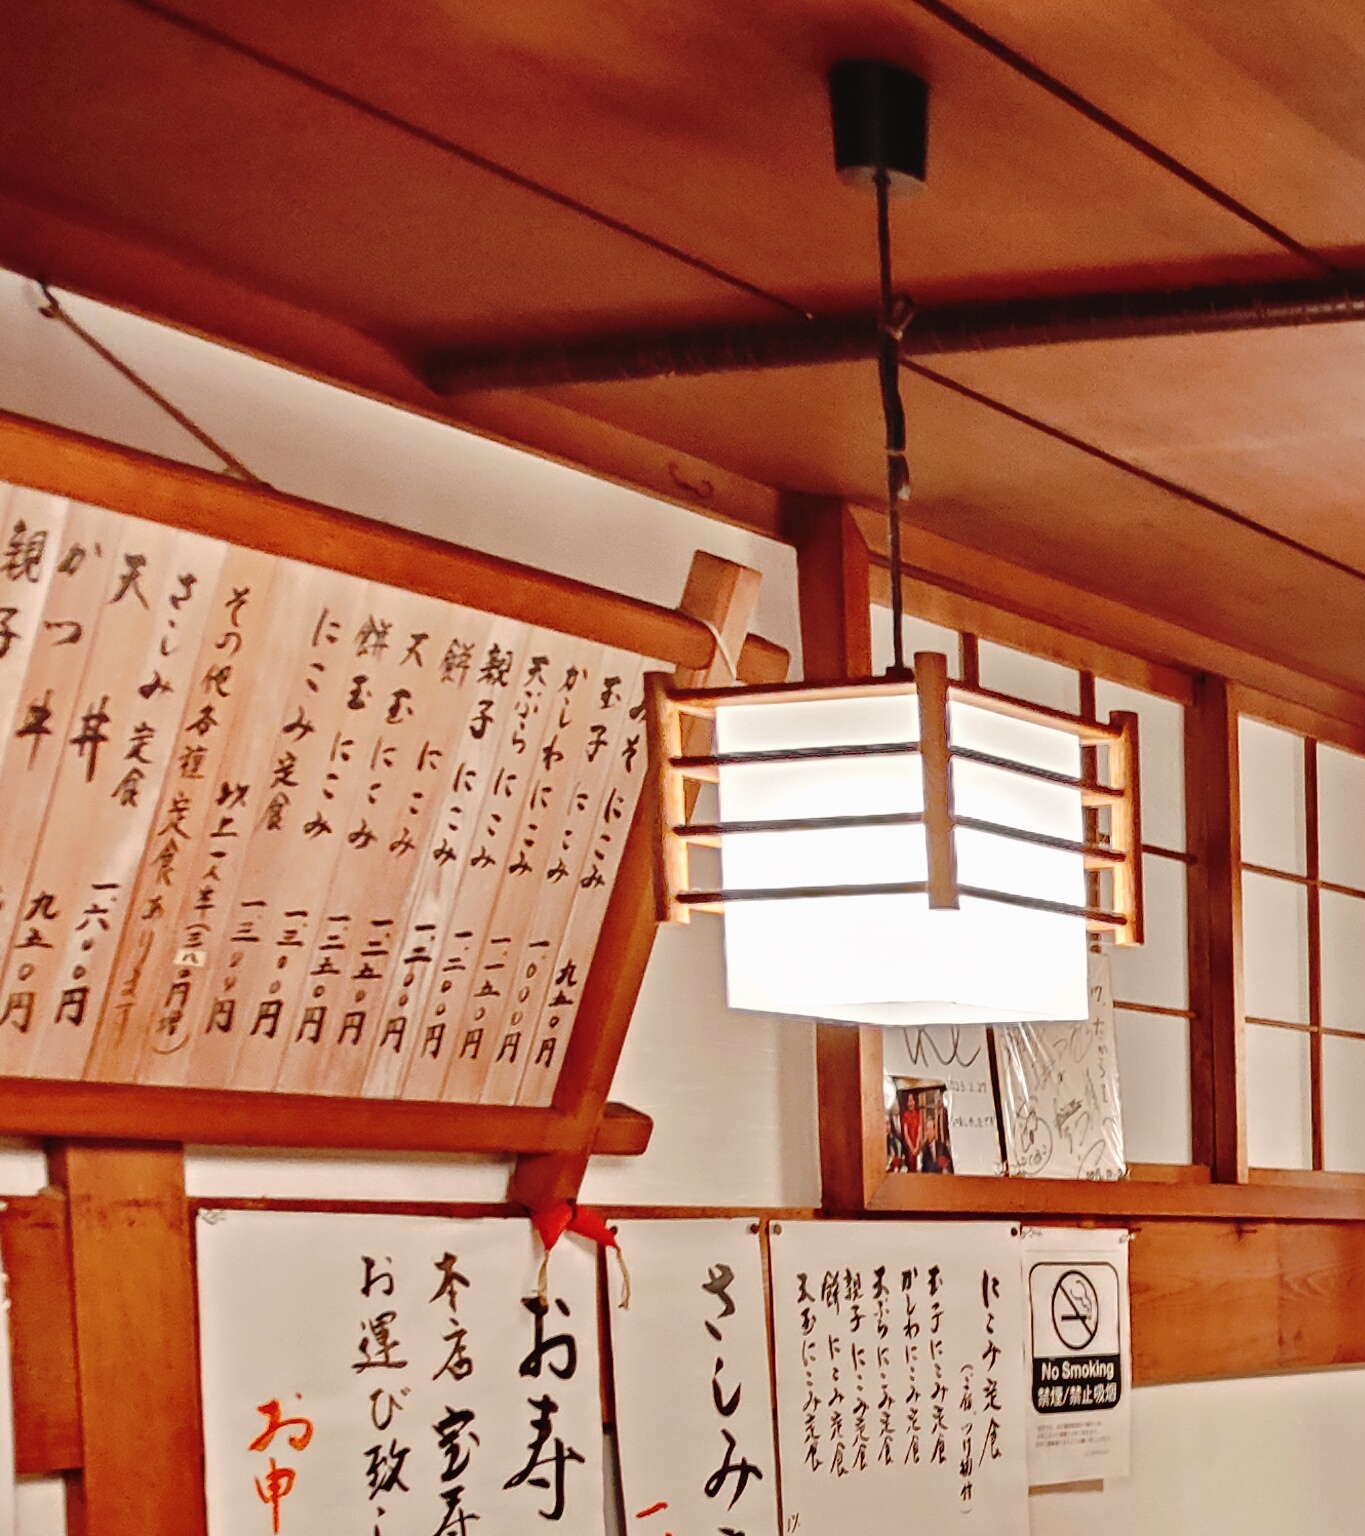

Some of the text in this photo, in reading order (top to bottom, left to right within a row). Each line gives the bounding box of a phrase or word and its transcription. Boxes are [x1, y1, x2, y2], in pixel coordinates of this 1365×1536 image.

[111, 573, 197, 808] さしみ定食
[258, 608, 341, 831] にこみ定食
[979, 1269, 1002, 1467] にこみ定食
[1041, 1360, 1115, 1381] No Smoking
